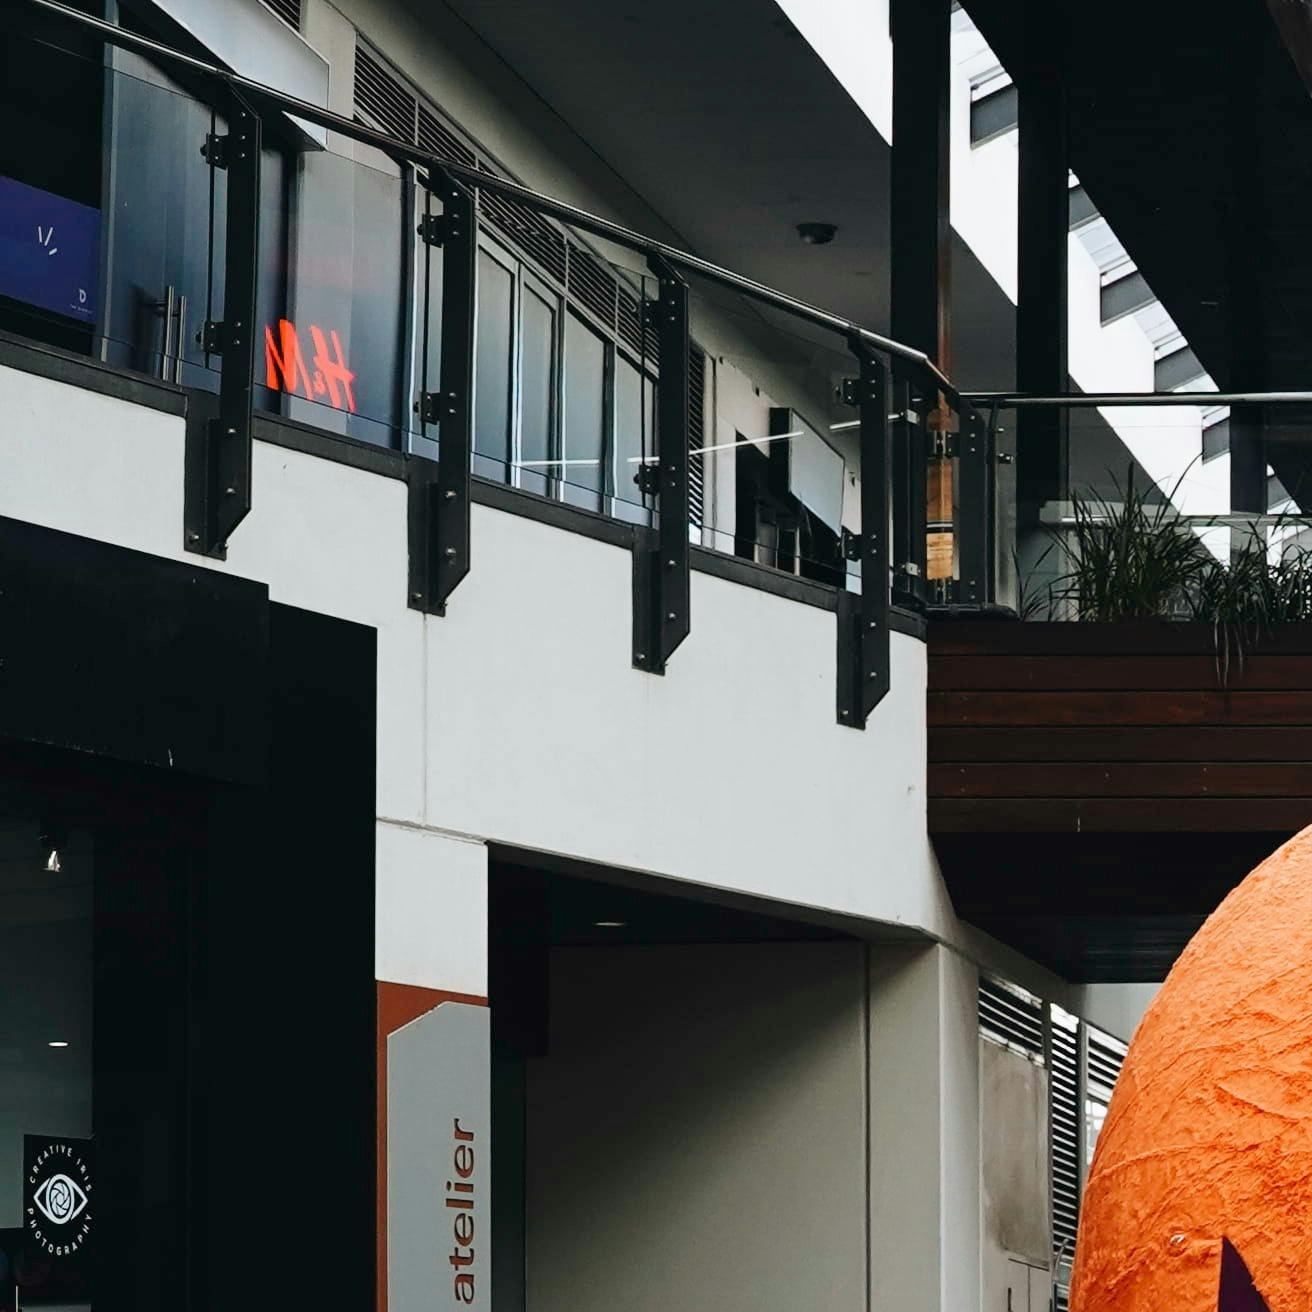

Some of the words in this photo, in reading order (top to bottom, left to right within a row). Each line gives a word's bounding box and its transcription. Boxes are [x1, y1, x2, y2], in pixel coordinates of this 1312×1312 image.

[30, 1144, 73, 1184] CREATIVE
[76, 1158, 92, 1192] IRIS
[27, 1207, 92, 1256] PHOTOGRAPHY
[446, 1118, 475, 1305] atelier
